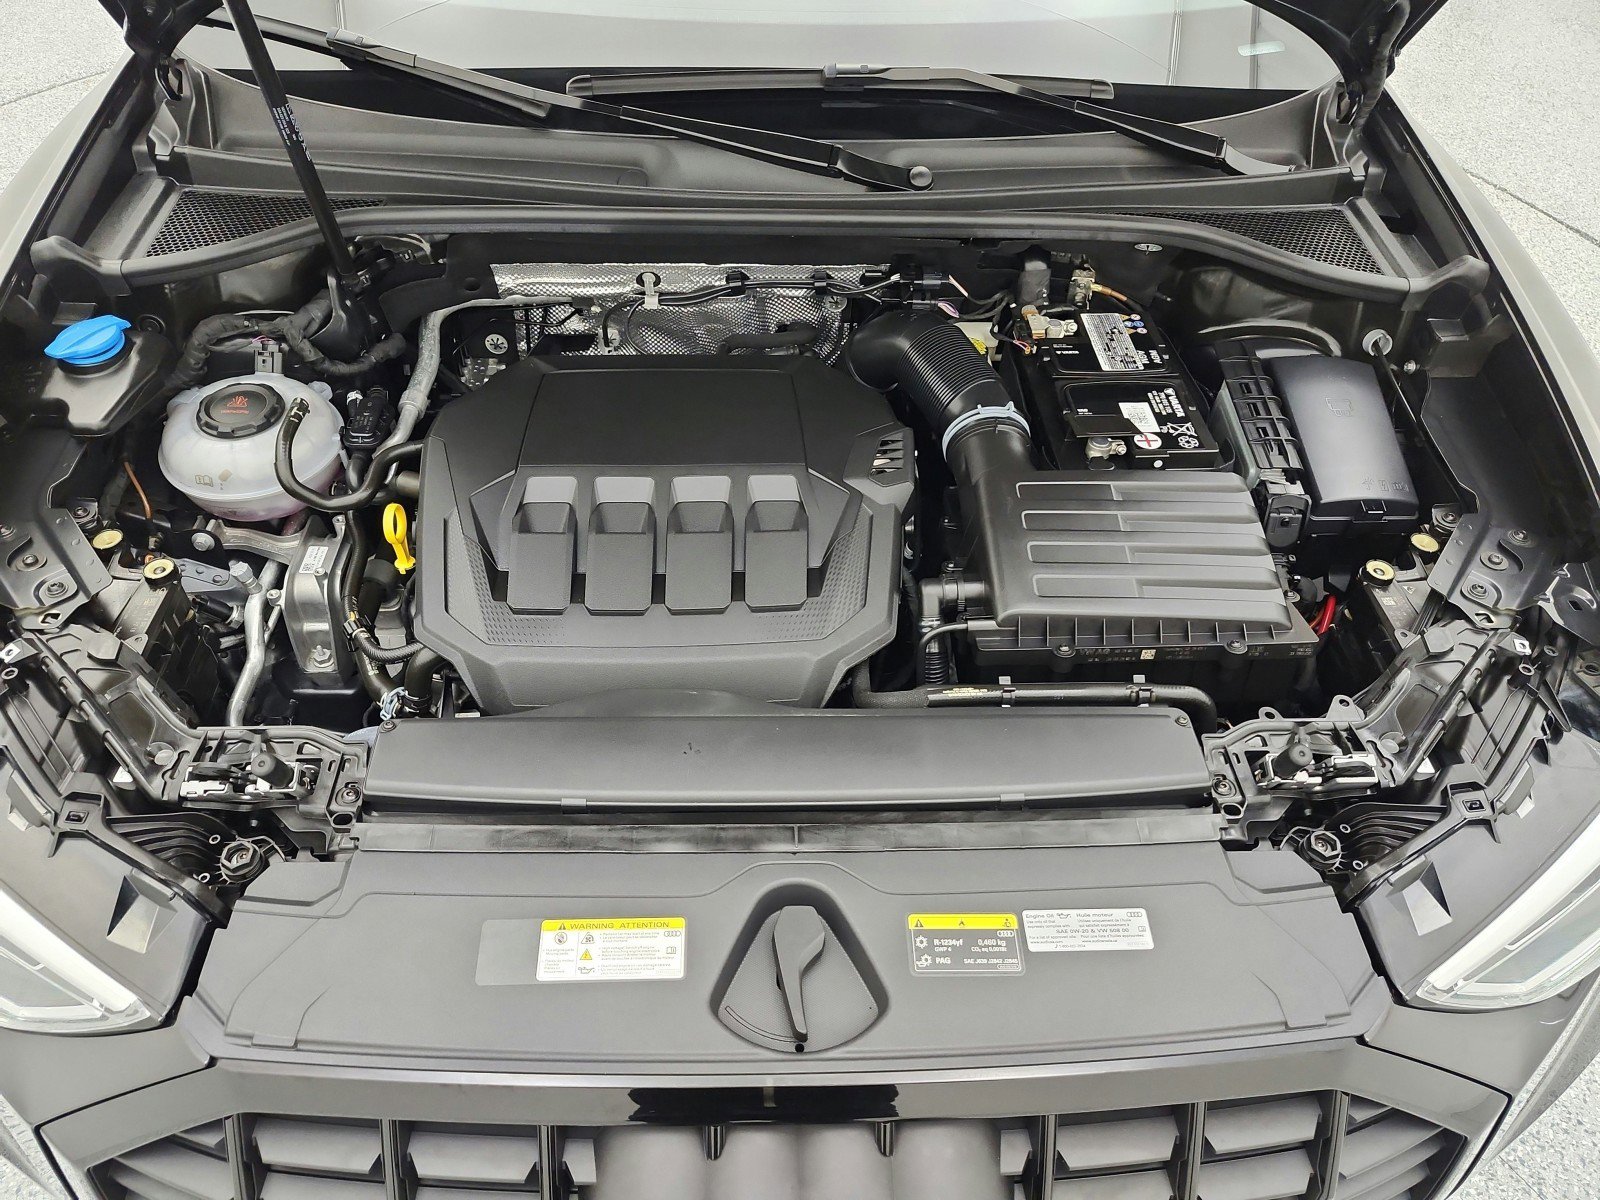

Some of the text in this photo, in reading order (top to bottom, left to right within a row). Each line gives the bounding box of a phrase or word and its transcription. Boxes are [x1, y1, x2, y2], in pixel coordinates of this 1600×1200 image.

[1168, 395, 1186, 417] VARTA
[619, 921, 669, 929] ATTENTION
[933, 938, 963, 947] R-1234yf
[997, 938, 1006, 948] kg
[935, 957, 951, 965] PAG
